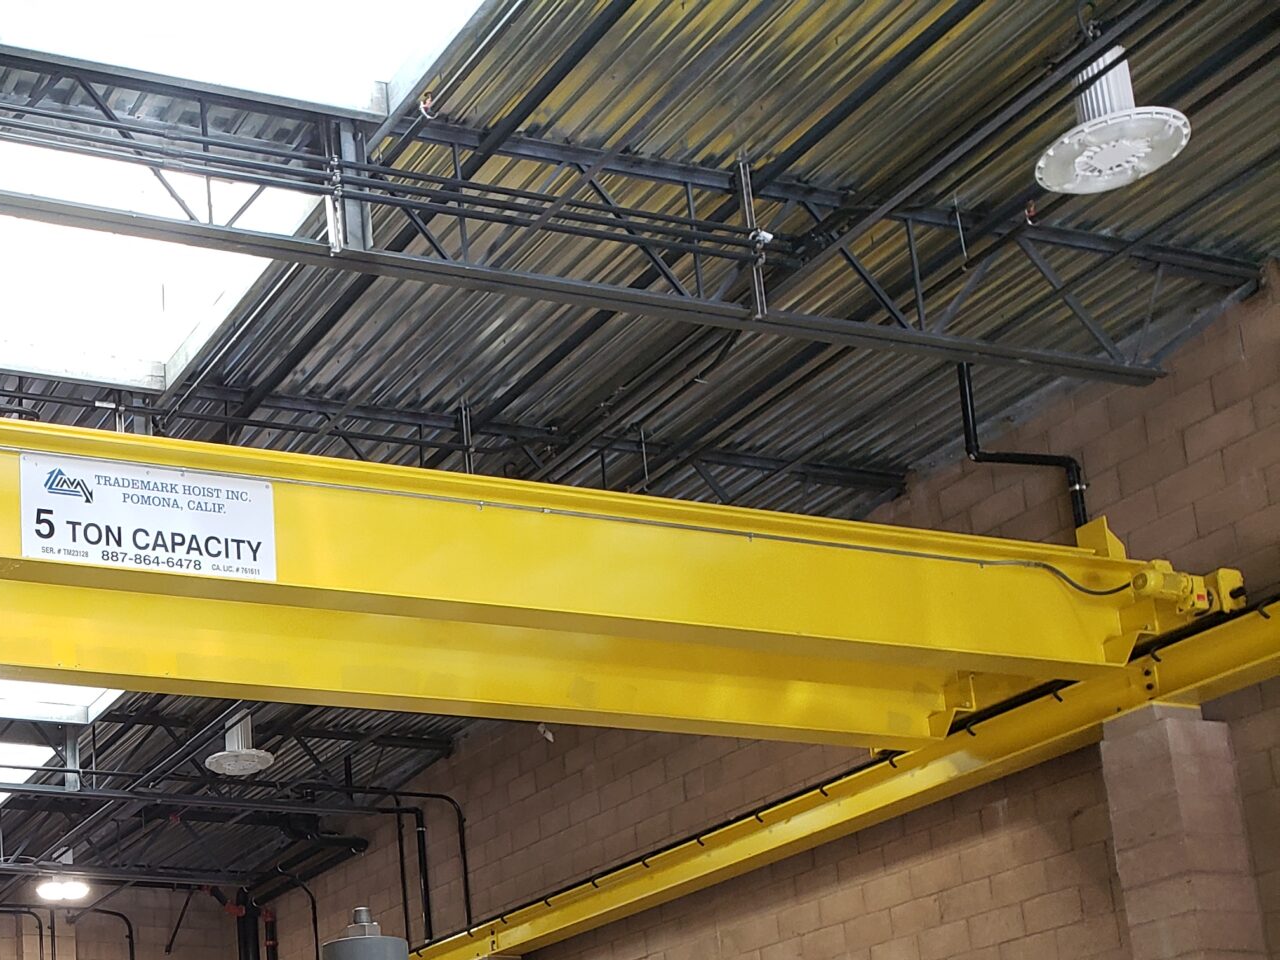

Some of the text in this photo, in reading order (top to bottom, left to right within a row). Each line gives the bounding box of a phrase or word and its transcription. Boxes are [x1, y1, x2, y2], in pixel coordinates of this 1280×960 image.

[94, 474, 252, 502] TRADEMARK HOIST INC.
[122, 492, 226, 514] POMONA, CALIF.
[34, 508, 262, 562] 5 TON CAPACITY
[41, 546, 56, 555] SER.
[101, 550, 202, 571] 887-864-6478
